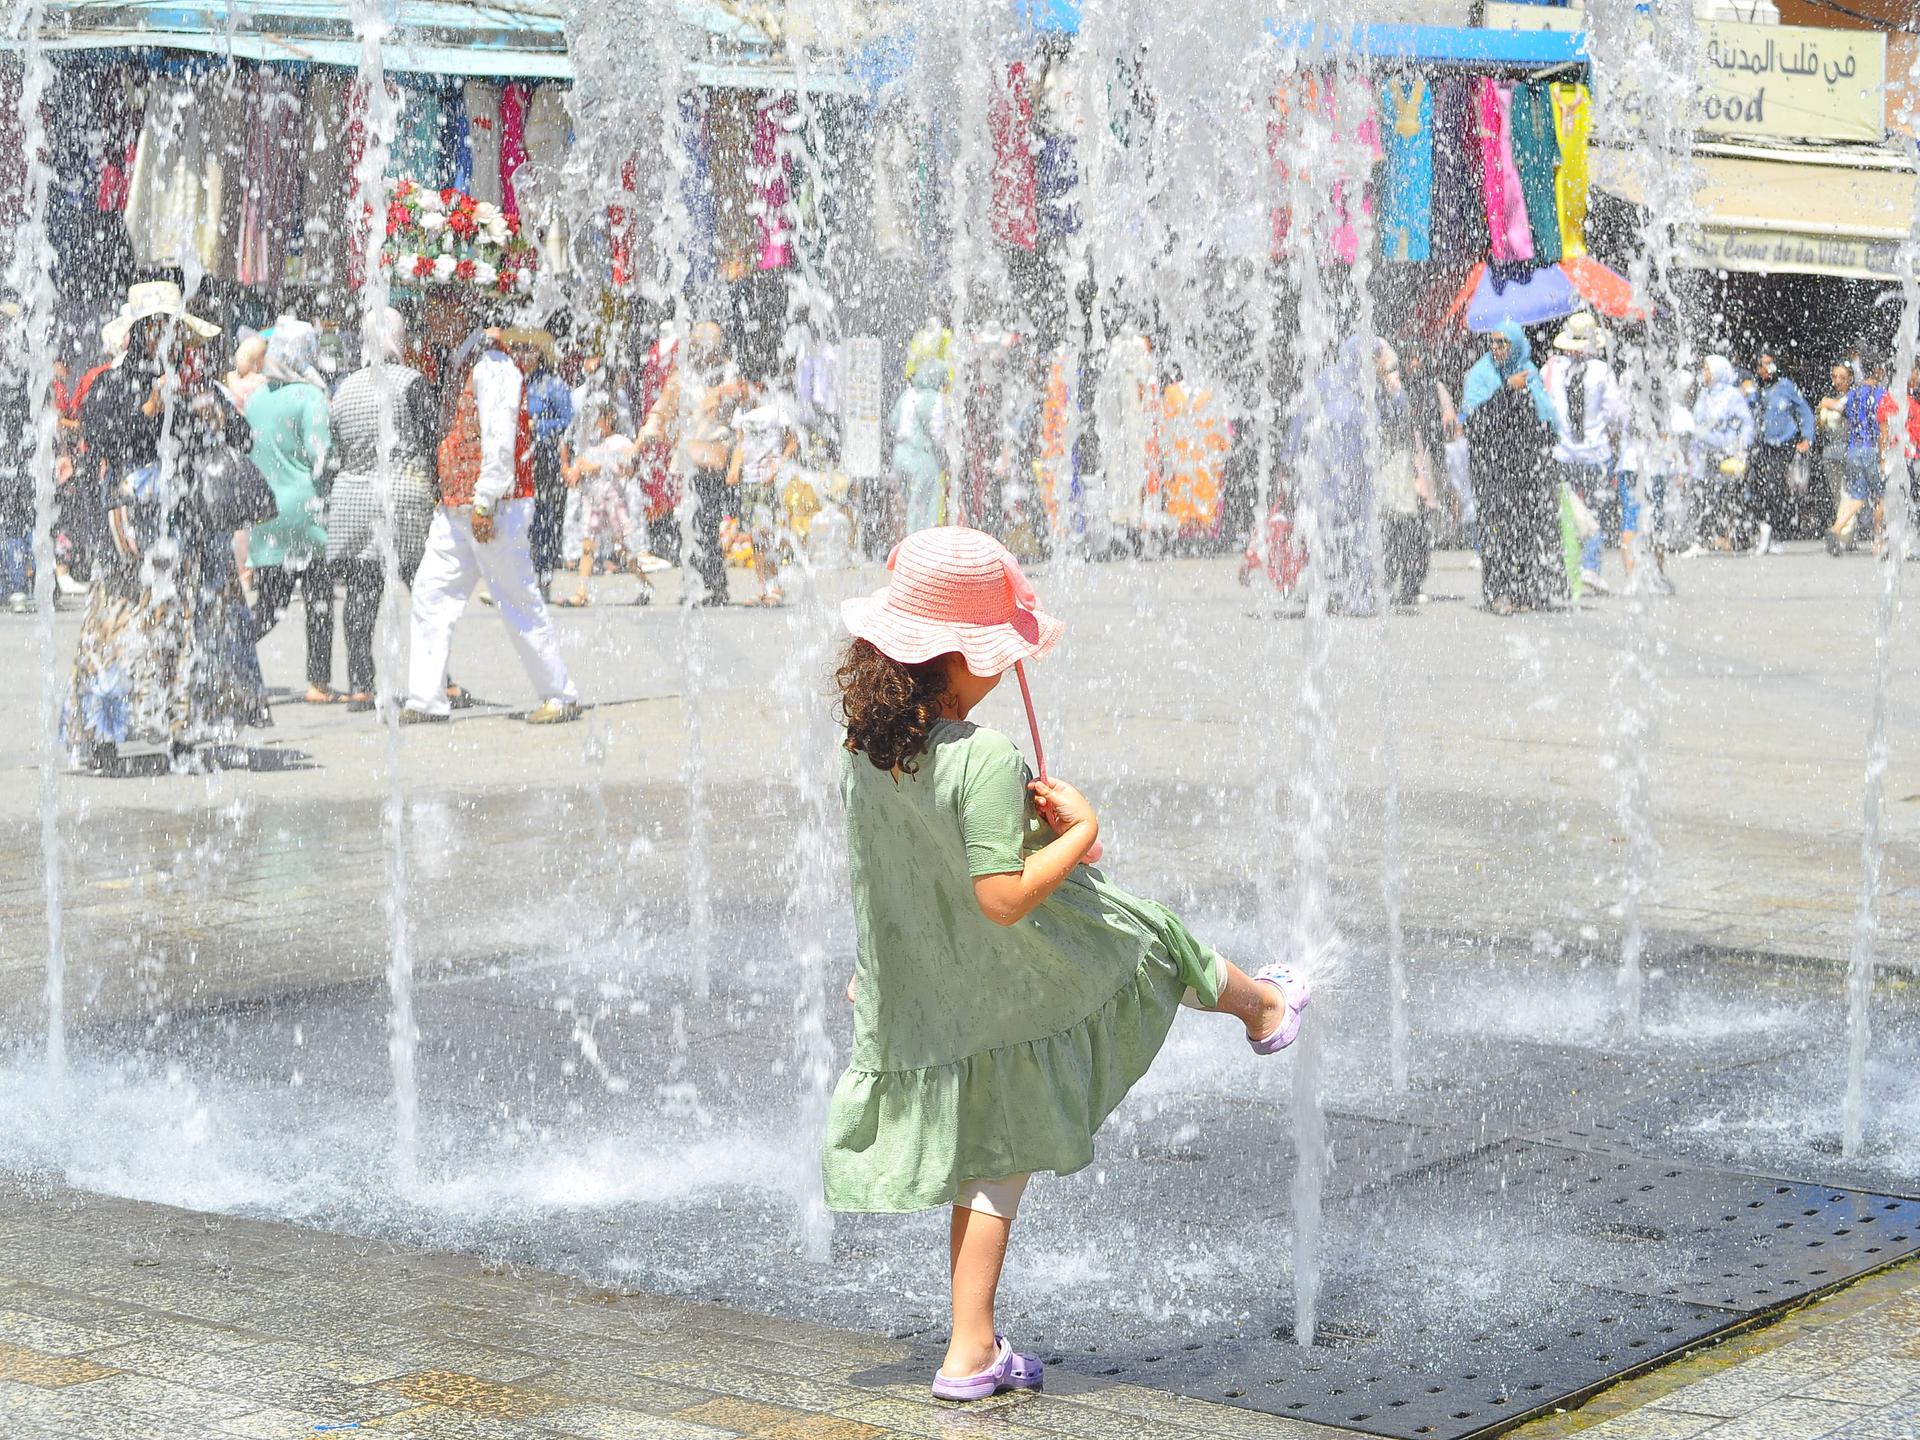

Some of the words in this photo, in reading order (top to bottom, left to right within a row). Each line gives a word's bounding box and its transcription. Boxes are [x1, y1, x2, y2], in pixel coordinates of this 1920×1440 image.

[1706, 31, 1774, 75] المدينة
[1779, 41, 1818, 82] قلب
[1823, 45, 1856, 93] في
